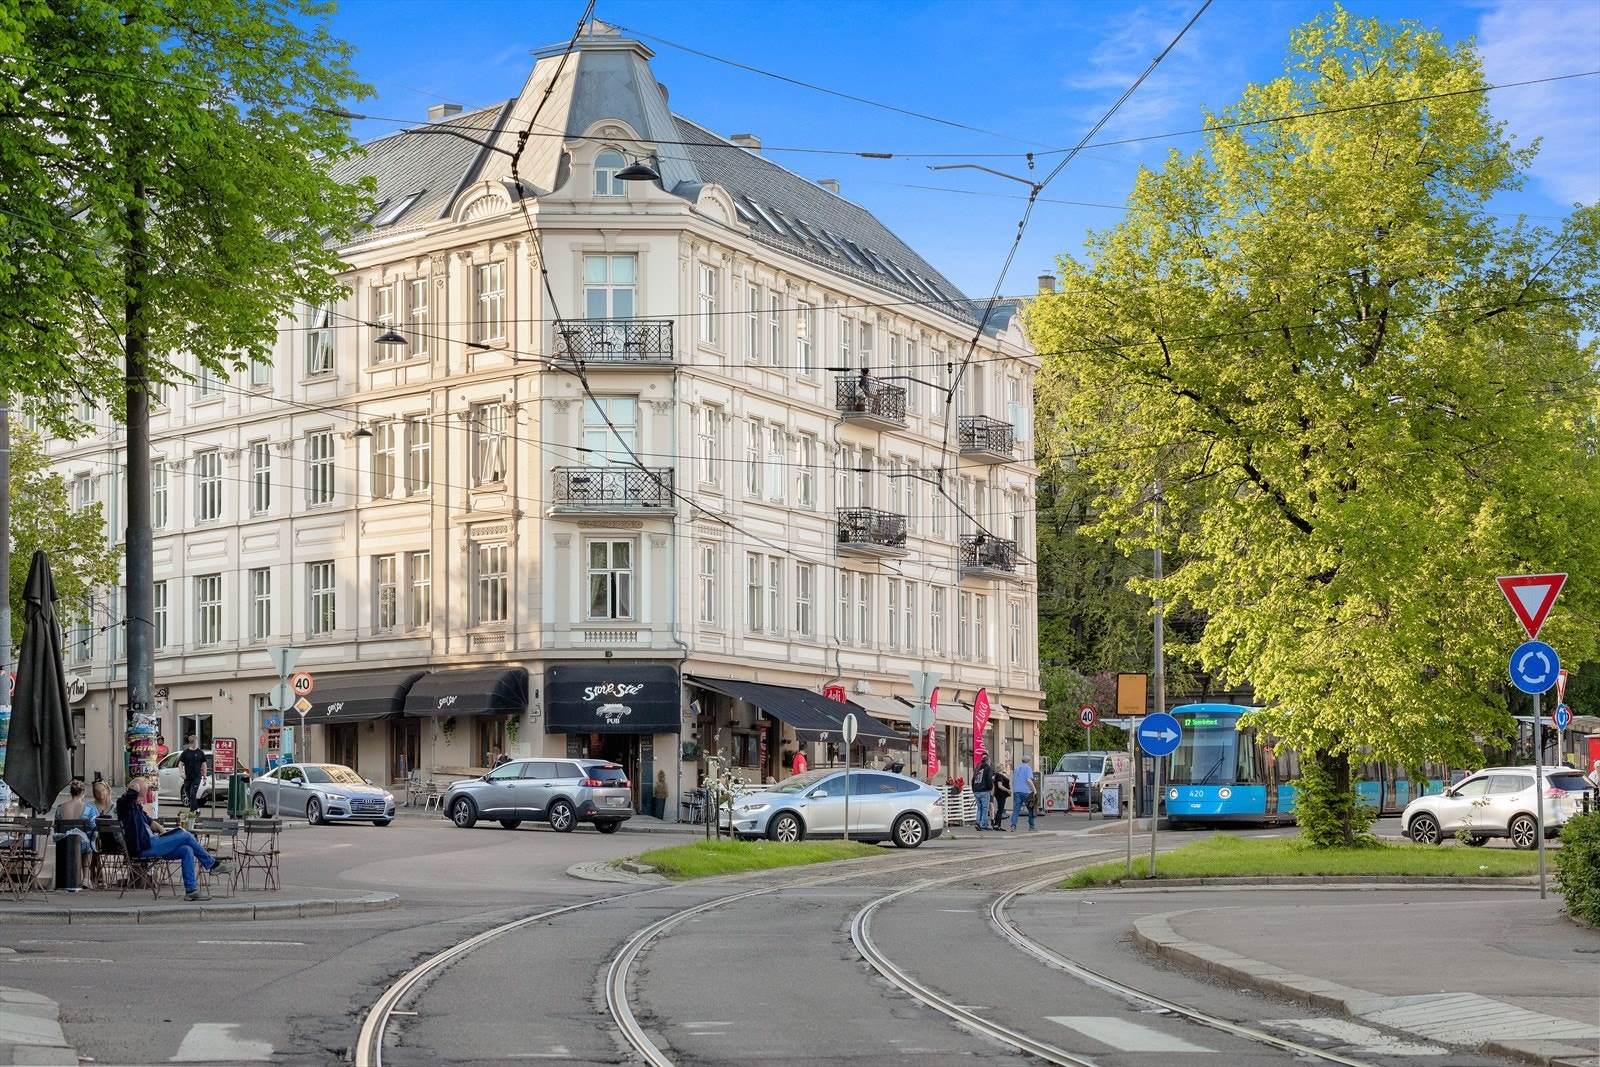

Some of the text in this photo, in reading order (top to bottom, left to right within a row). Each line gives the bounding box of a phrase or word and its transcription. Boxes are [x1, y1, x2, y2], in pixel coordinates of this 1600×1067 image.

[295, 678, 310, 690] 40
[582, 682, 614, 701] Store
[1082, 711, 1093, 722] 40
